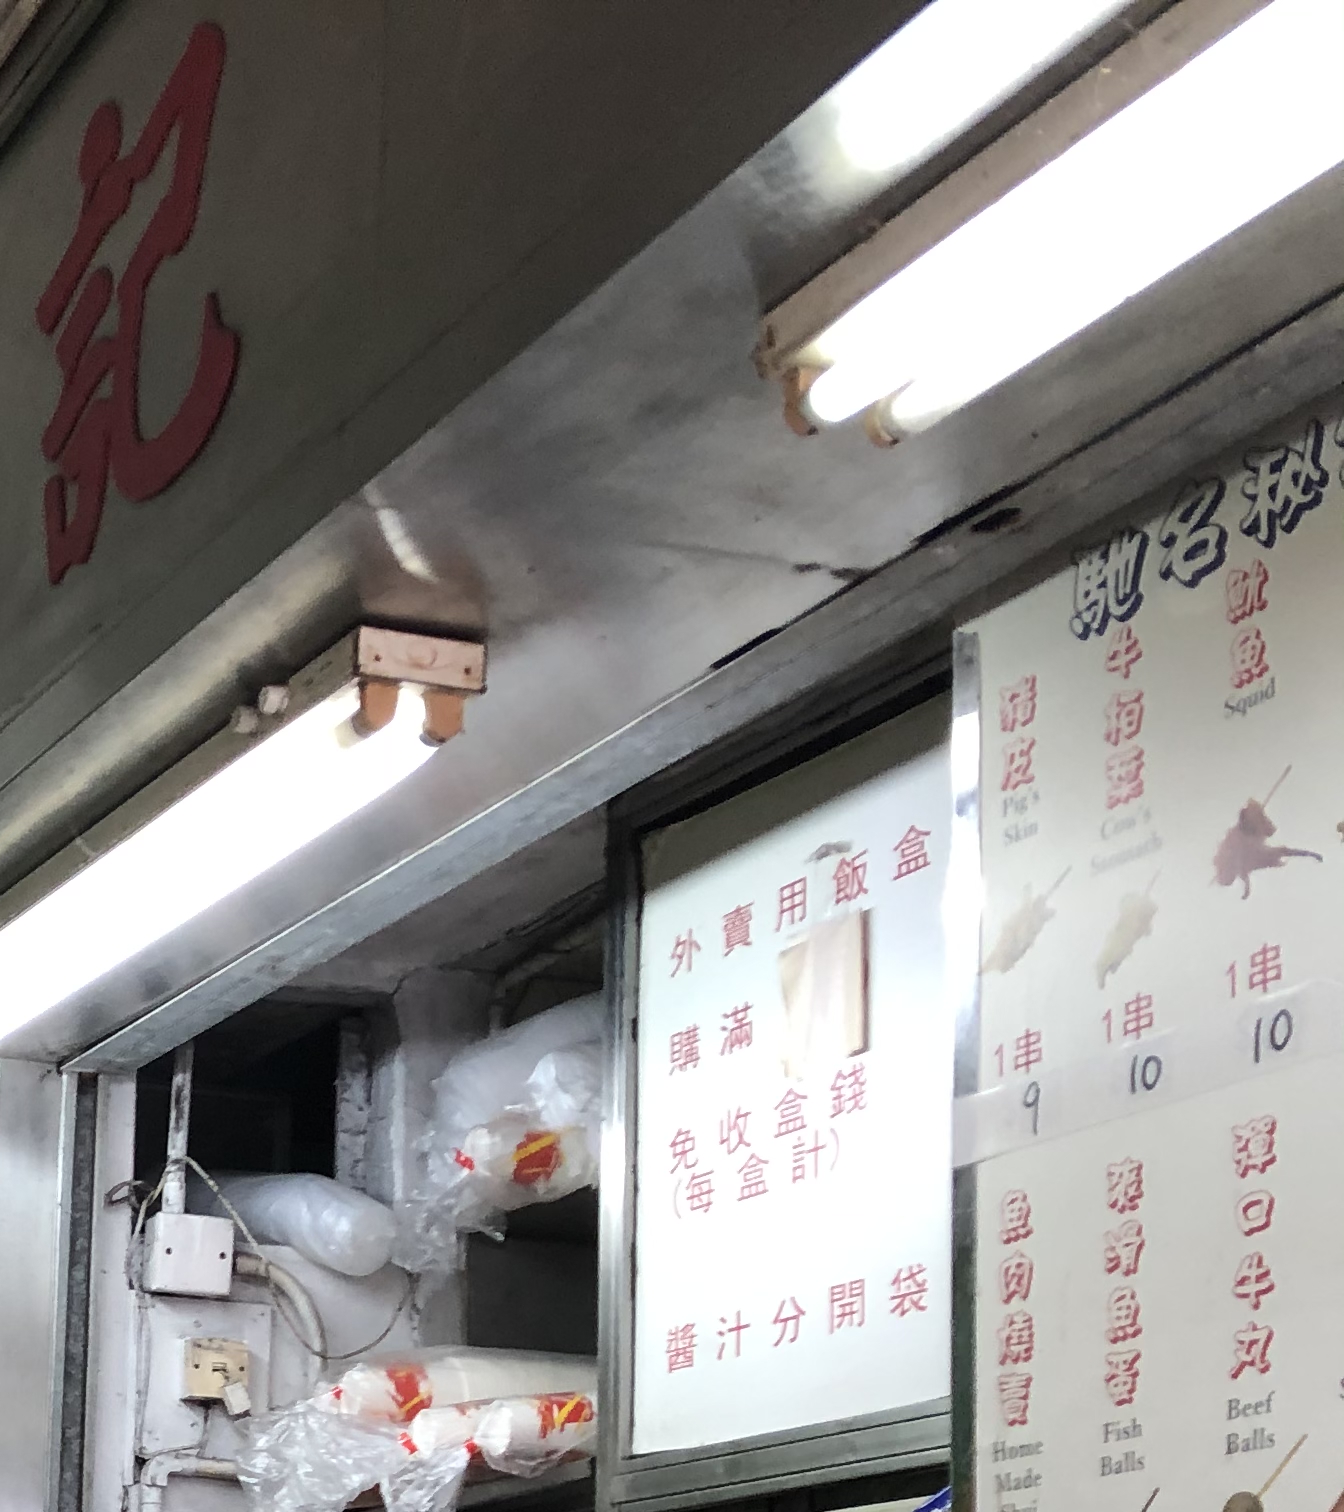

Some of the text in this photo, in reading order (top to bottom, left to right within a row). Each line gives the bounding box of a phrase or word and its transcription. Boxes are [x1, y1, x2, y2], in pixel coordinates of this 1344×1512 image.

[1070, 415, 1344, 641] 馳名秘
[1224, 677, 1276, 719] Squid
[668, 824, 933, 978] 外賣用飯盒
[1226, 942, 1282, 999] 1串
[1102, 992, 1154, 1044] 1串
[1253, 1008, 1294, 1064] 10
[994, 1028, 1043, 1077] 1串
[1129, 1054, 1163, 1095] 10
[668, 1062, 869, 1174] 免收盒錢
[1023, 1080, 1041, 1136] 9
[1229, 1112, 1279, 1384] 彈口牛丸
[665, 1263, 929, 1374] 醬汁分開袋
[997, 1189, 1035, 1426] 魚肉燒賣
[1102, 1418, 1143, 1444] Fish
[1226, 1390, 1276, 1421] Beef
[991, 1440, 1044, 1463] Home
[1100, 1450, 1146, 1477] Balls
[1225, 1427, 1276, 1455] Balls
[995, 1468, 1043, 1494] Made
